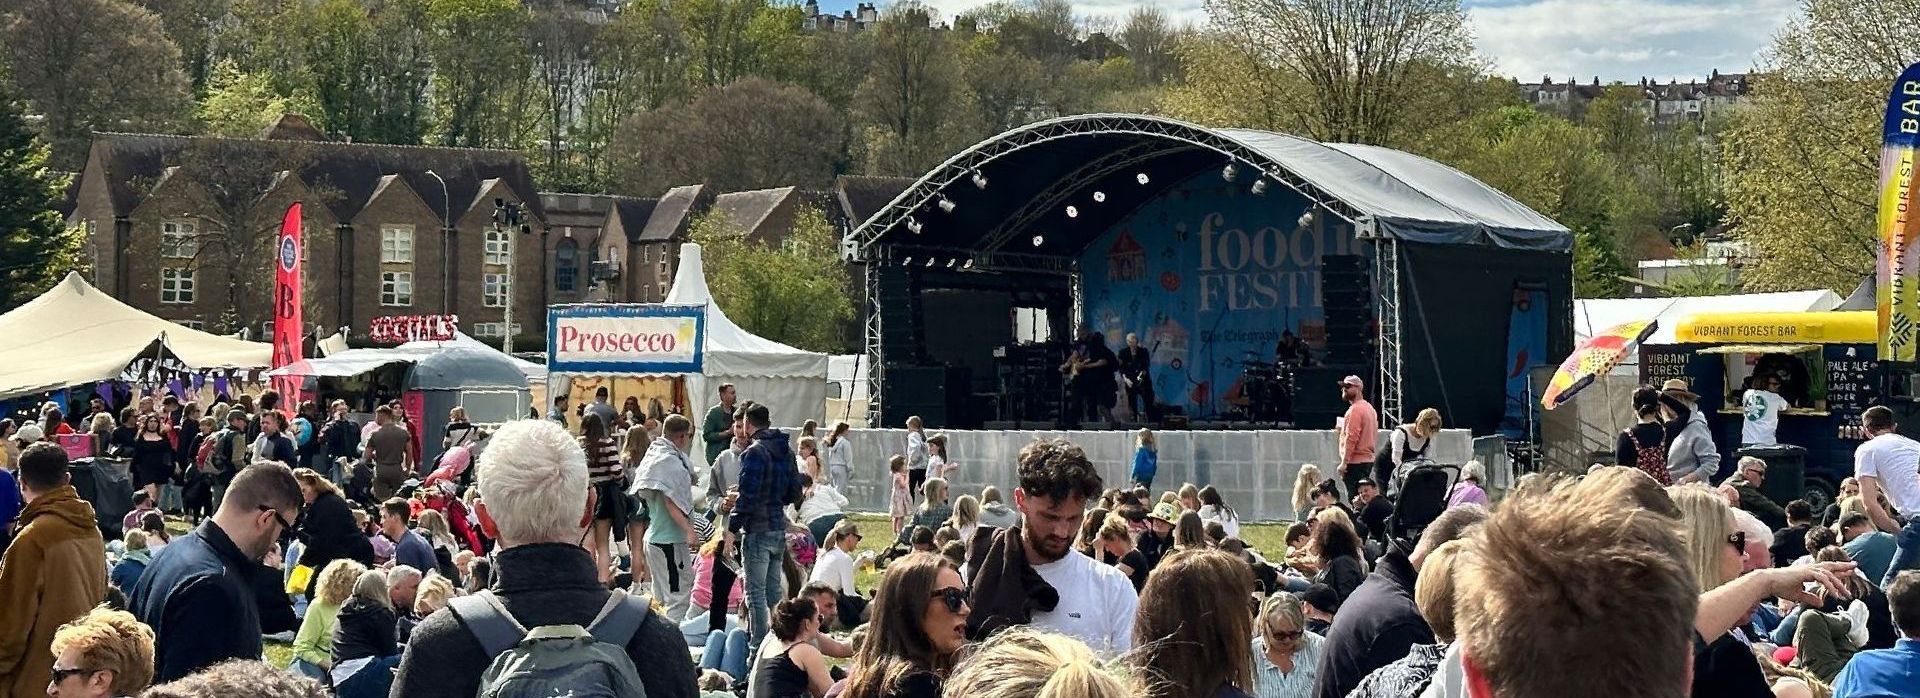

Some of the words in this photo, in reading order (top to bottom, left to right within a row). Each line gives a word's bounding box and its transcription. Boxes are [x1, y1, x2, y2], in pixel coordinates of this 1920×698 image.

[1901, 80, 1920, 134] BAR
[1896, 157, 1913, 224] FOREST
[1197, 209, 1364, 271] foodi
[1893, 232, 1905, 306] VIBRANT
[1198, 270, 1324, 313] FESTI
[1693, 325, 1735, 337] VIBRANT
[1737, 325, 1775, 337] FOREST
[1777, 325, 1797, 337] BAR
[559, 325, 676, 353] Prosecco
[1647, 353, 1691, 364] VIBRANT
[1647, 364, 1686, 375] FOREST
[1827, 361, 1848, 372] PALE
[1851, 360, 1869, 371] ALE
[1648, 375, 1695, 387] BREY
[1827, 383, 1857, 391] LAGER
[1827, 393, 1856, 401] CIDER
